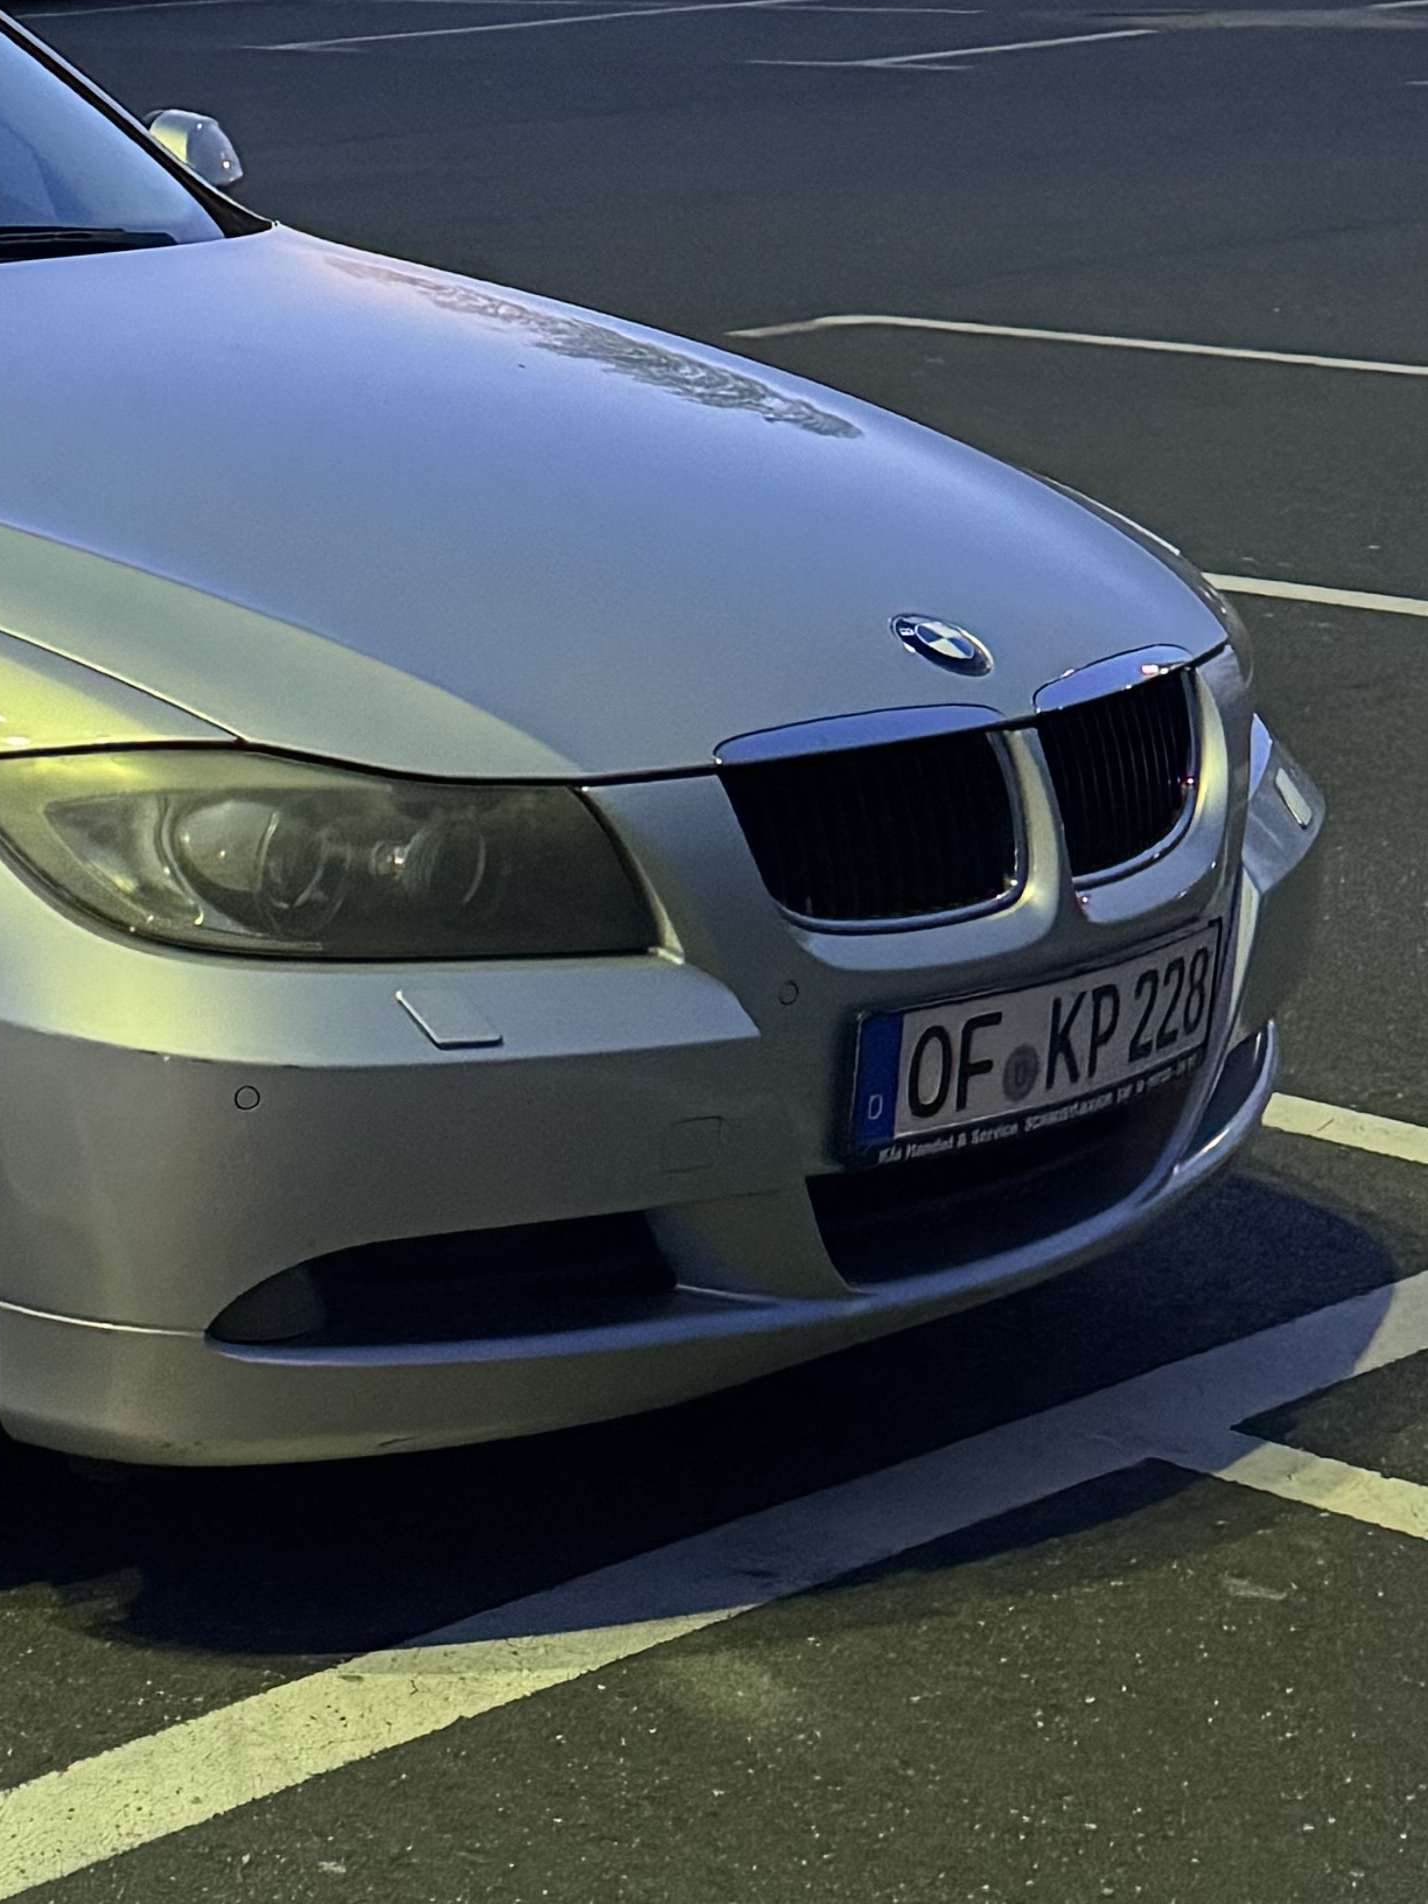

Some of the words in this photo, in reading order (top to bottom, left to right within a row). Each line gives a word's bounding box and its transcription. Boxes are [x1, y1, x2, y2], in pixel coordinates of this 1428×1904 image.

[908, 1011, 1002, 1118] OF
[1046, 984, 1120, 1090] KP
[1128, 946, 1209, 1063] 228
